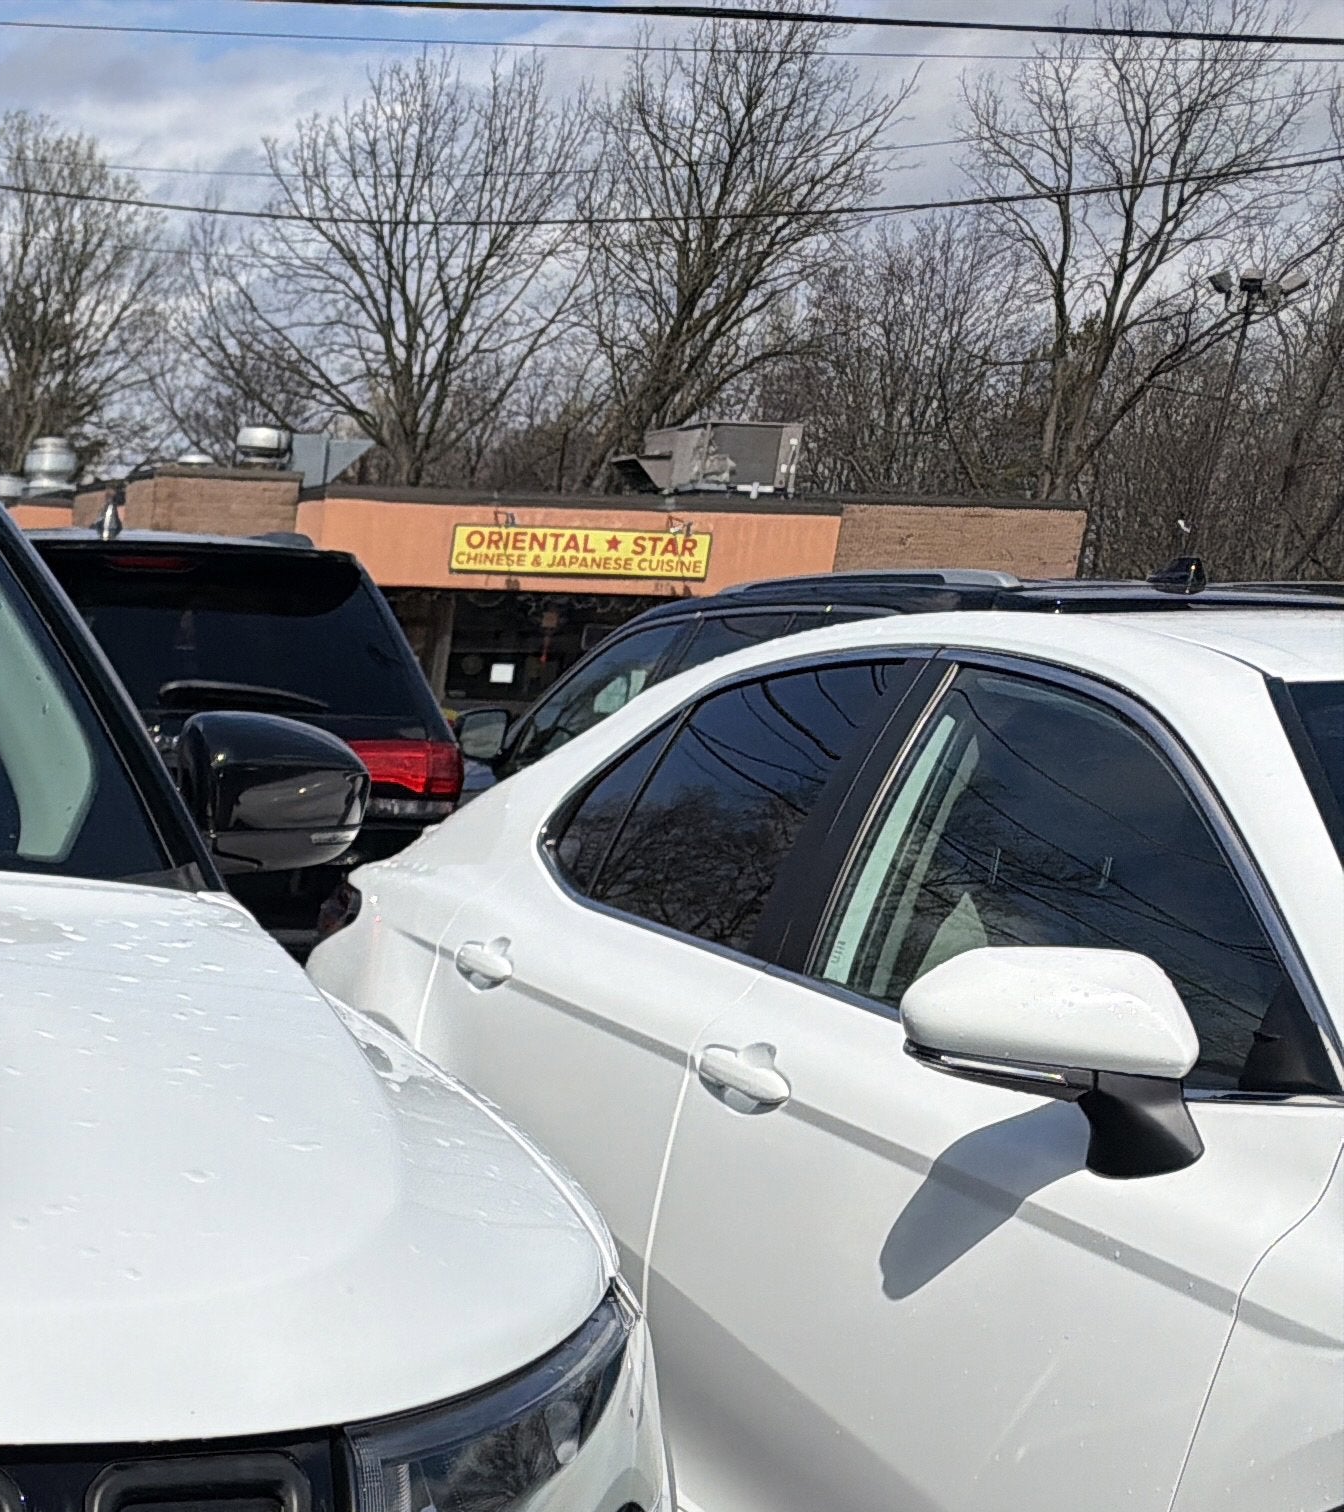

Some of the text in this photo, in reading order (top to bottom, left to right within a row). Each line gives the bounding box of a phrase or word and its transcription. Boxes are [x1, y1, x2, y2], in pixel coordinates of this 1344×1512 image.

[466, 530, 698, 557] ORIENTAL STAR
[455, 551, 702, 574] CHINESE & JAPANESE CUISINE
